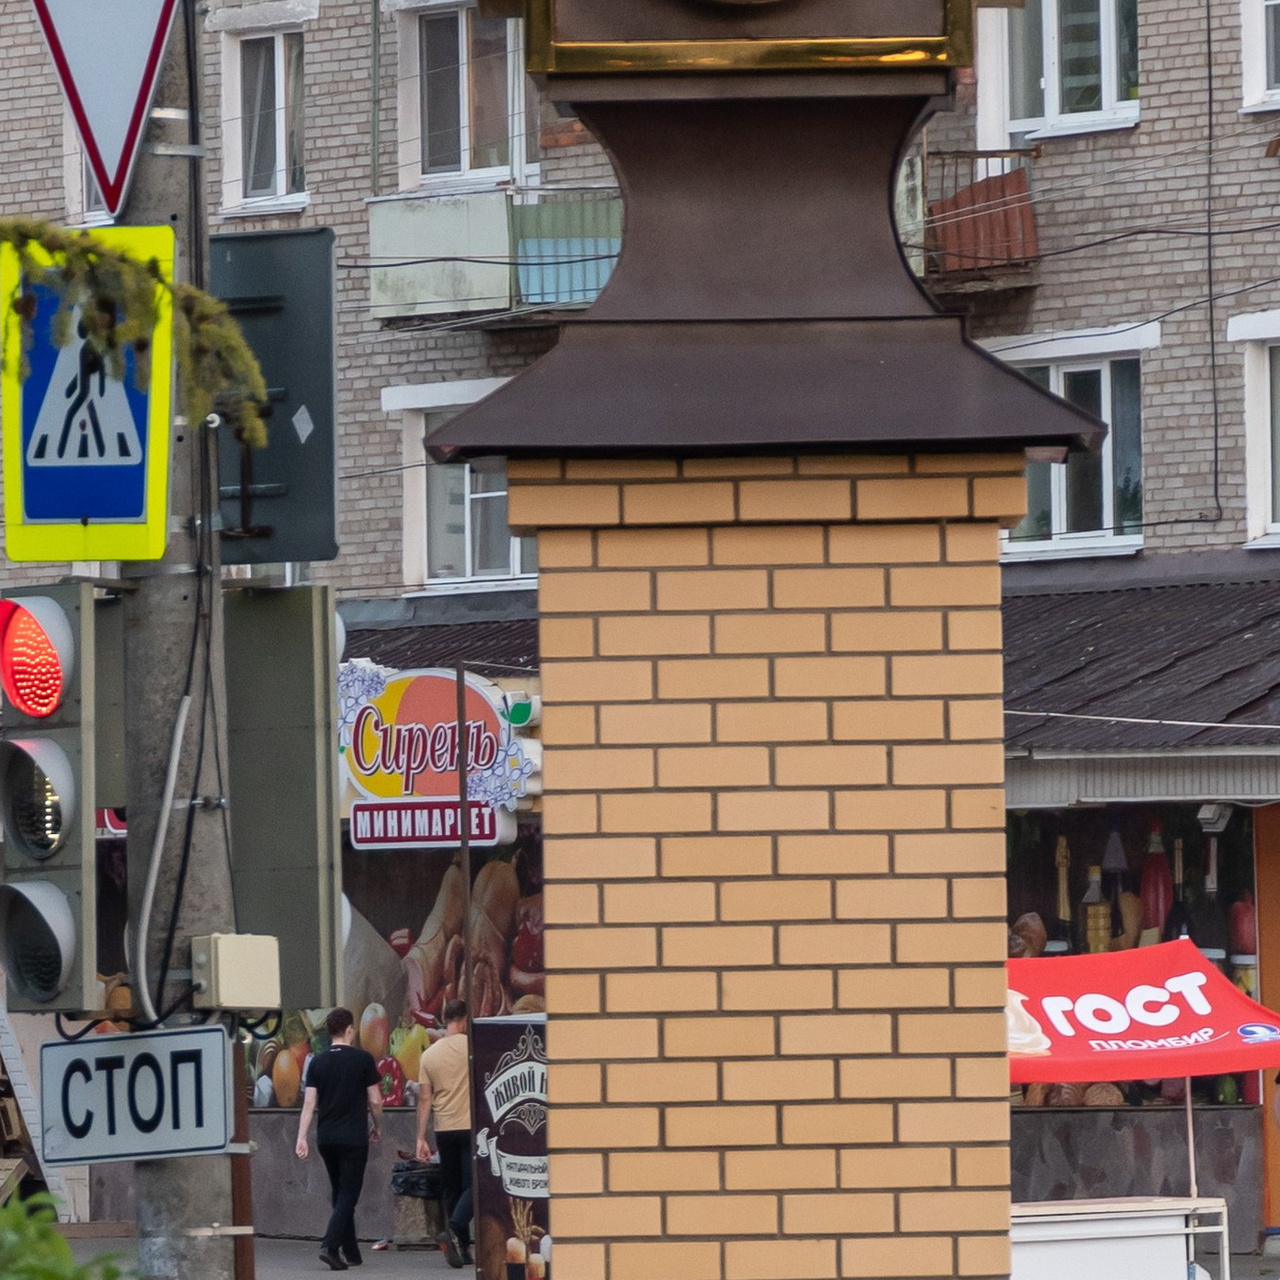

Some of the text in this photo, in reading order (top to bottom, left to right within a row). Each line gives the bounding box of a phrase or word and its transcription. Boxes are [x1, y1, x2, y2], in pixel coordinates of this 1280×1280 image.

[352, 704, 498, 794] Сирень
[1041, 971, 1213, 1037] ГОСТ
[1088, 1027, 1215, 1051] ПЛОМБИР
[61, 1048, 204, 1139] СТОП
[491, 1066, 536, 1111] ЖИВОЙ
